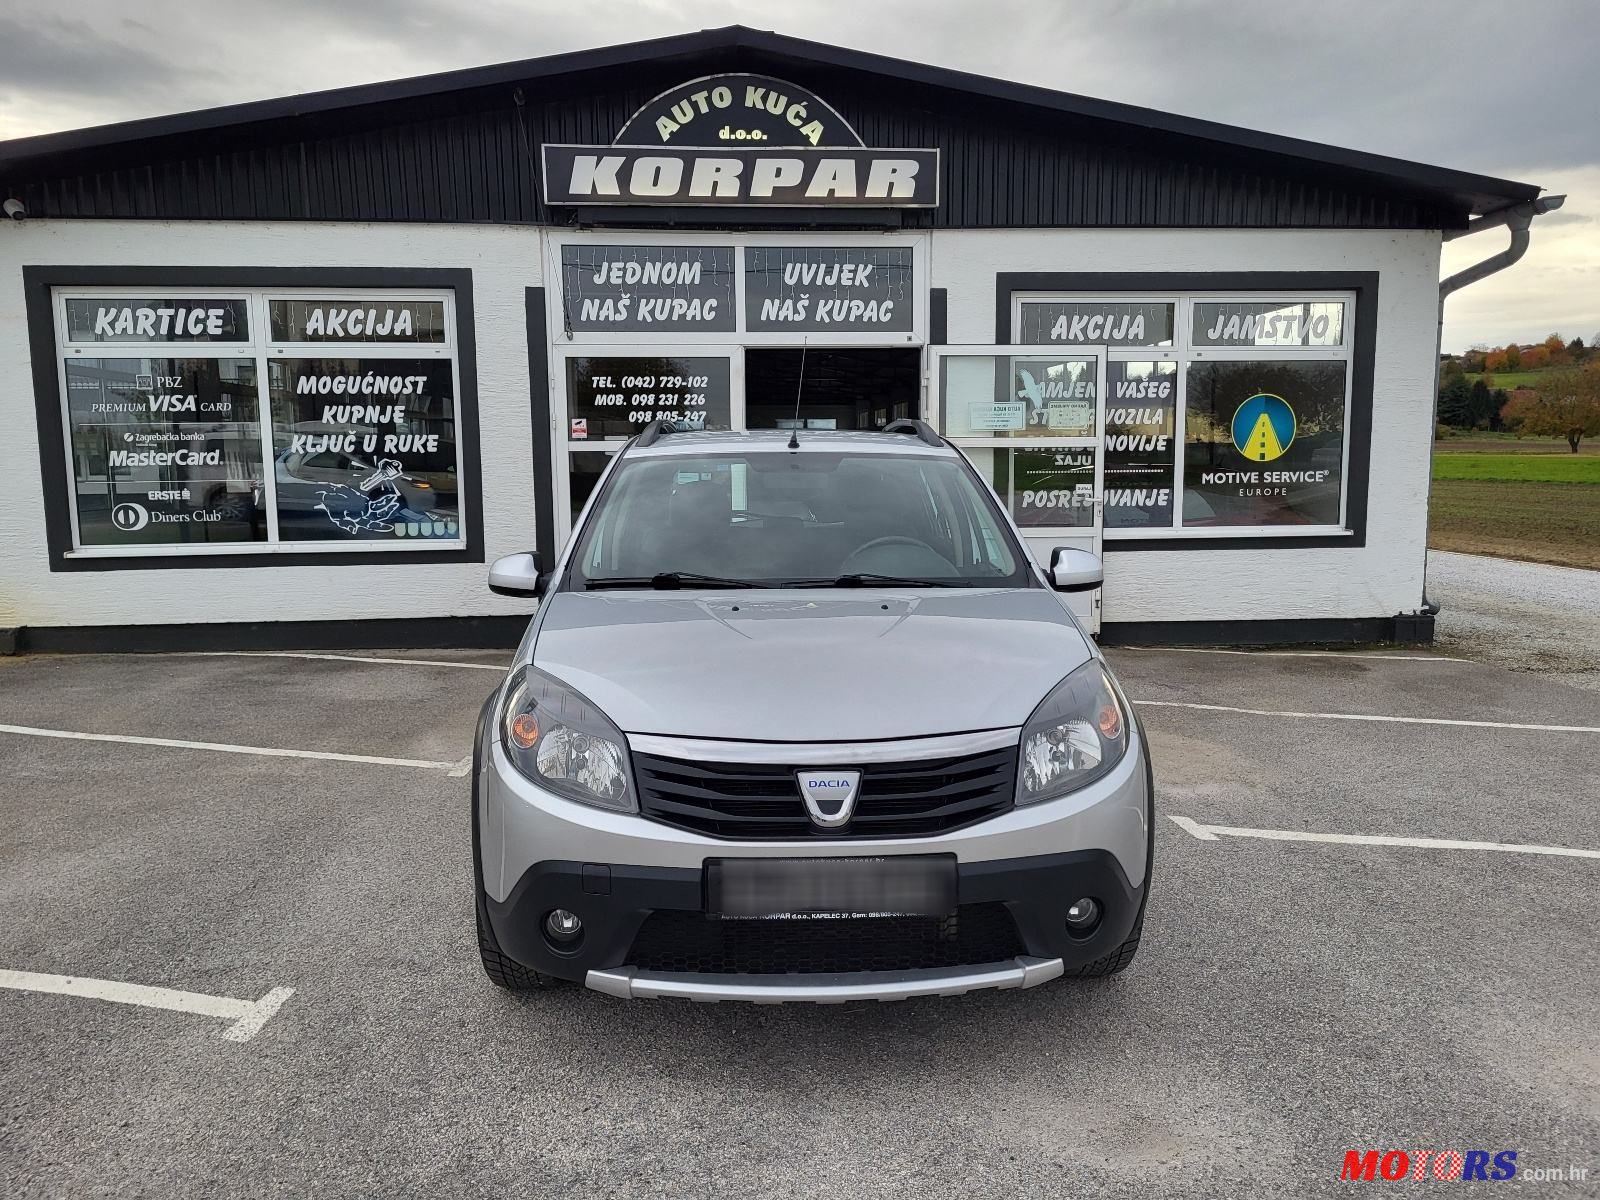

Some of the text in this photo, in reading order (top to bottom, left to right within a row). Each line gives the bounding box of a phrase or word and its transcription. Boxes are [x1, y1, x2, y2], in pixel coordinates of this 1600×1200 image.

[654, 85, 825, 146] AUTO KUĆA
[718, 125, 768, 141] d.o.o.
[568, 155, 920, 198] KORPAR
[592, 260, 703, 286] JEDNOM
[783, 262, 874, 289] UVIJEK
[580, 293, 718, 323] NAŠ KUPAC
[760, 293, 895, 324] NAŠ KUPAC
[94, 307, 225, 337] KARTICE
[305, 308, 414, 337] AKCIJA
[1050, 313, 1146, 342] AKCIJA
[1207, 312, 1330, 341] JAMSTVO
[156, 376, 183, 388] PBZ
[296, 371, 427, 396] MOGUĆNOST
[591, 375, 708, 389] TEL. (042) 729-102
[1116, 377, 1171, 399] VAŠEG
[91, 394, 232, 413] PREMIUM VISA CARD
[594, 393, 706, 407] MOB. 098 231 226
[322, 405, 406, 425] KUPNJE
[628, 411, 652, 423] 098
[1105, 408, 1164, 425] VOZILA
[181, 432, 205, 441] banka
[290, 431, 439, 455] KLJUČ U RUKE
[1105, 434, 1168, 452] NOVIJE
[1201, 472, 1259, 485] MOTIVE
[148, 491, 181, 501] ERSTE
[1022, 488, 1170, 509] POSREVANJE
[1239, 487, 1288, 497] EUROPE
[151, 510, 221, 523] Diners Club
[808, 779, 850, 788] DACIA
